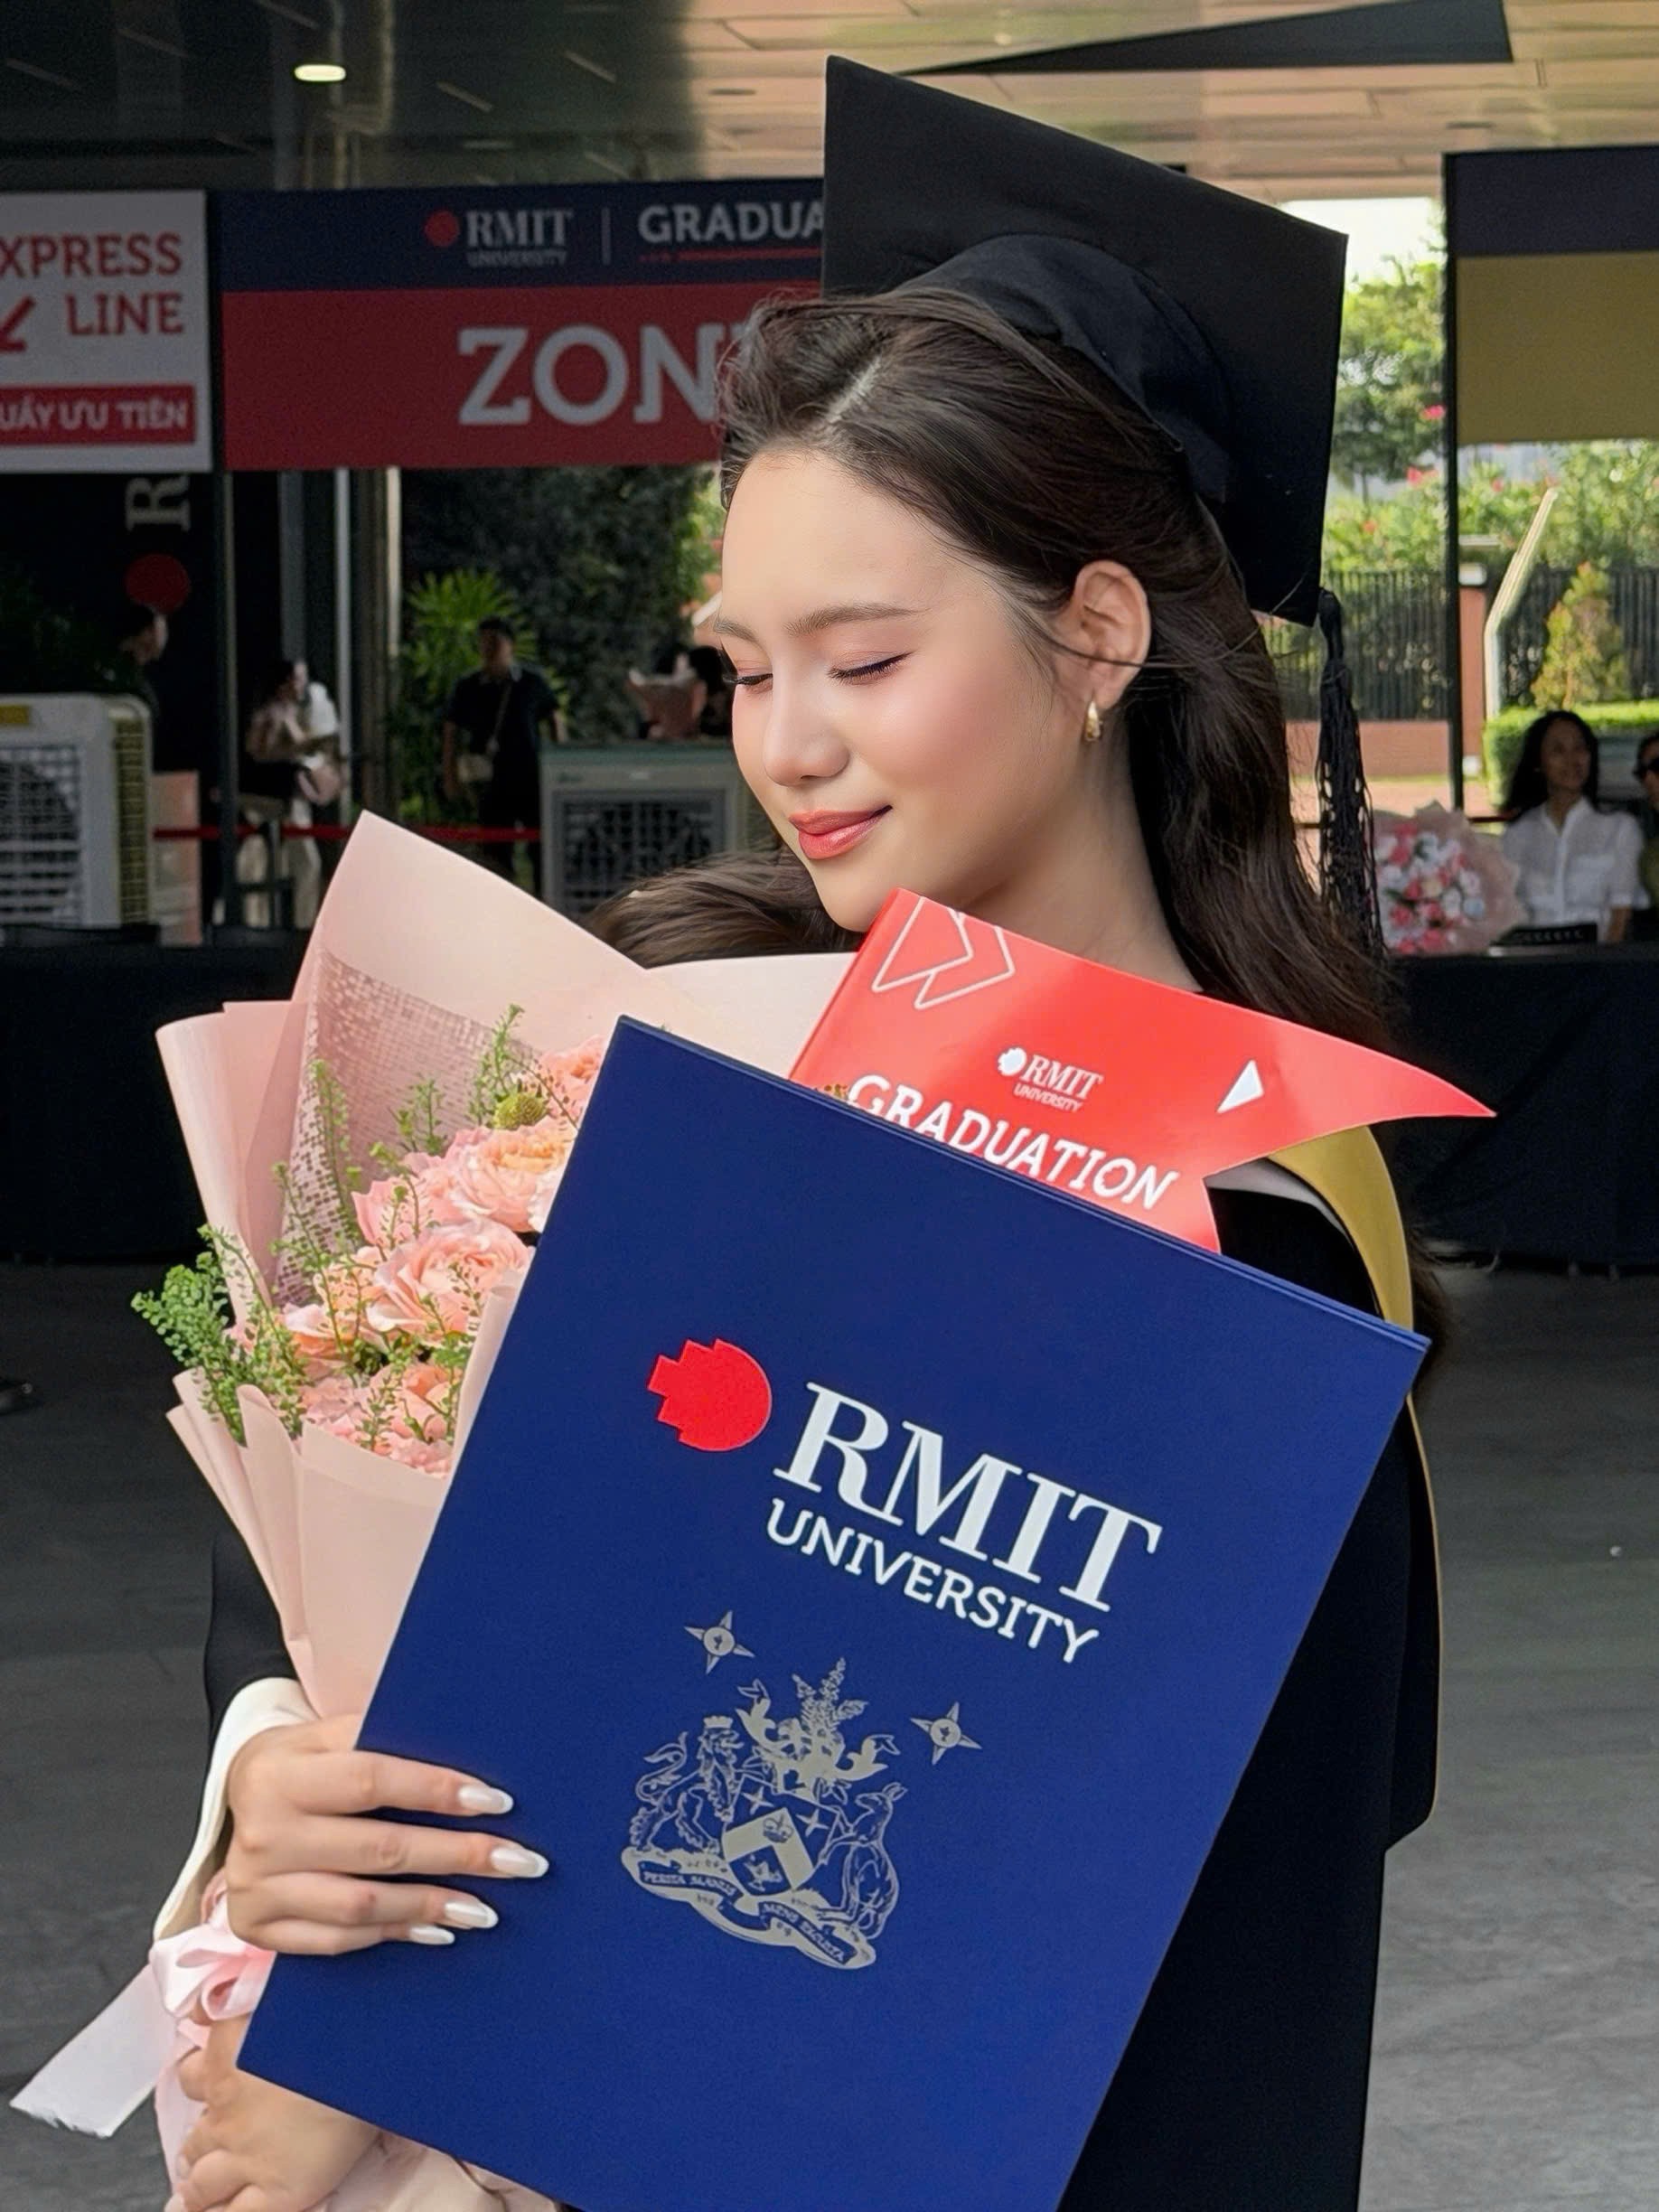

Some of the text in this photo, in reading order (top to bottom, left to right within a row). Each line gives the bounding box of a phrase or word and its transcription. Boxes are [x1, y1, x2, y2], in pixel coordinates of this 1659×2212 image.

[466, 209, 574, 246] RMIT
[65, 290, 185, 336] LINE
[457, 323, 746, 426] ZON
[1012, 1082, 1083, 1112] UNIVERSITY
[1019, 1053, 1104, 1101] RMIT
[847, 1073, 1180, 1210] GRADUATION
[772, 1381, 1163, 1613] RMIT
[765, 1497, 1101, 1664] UNIVERSITY
